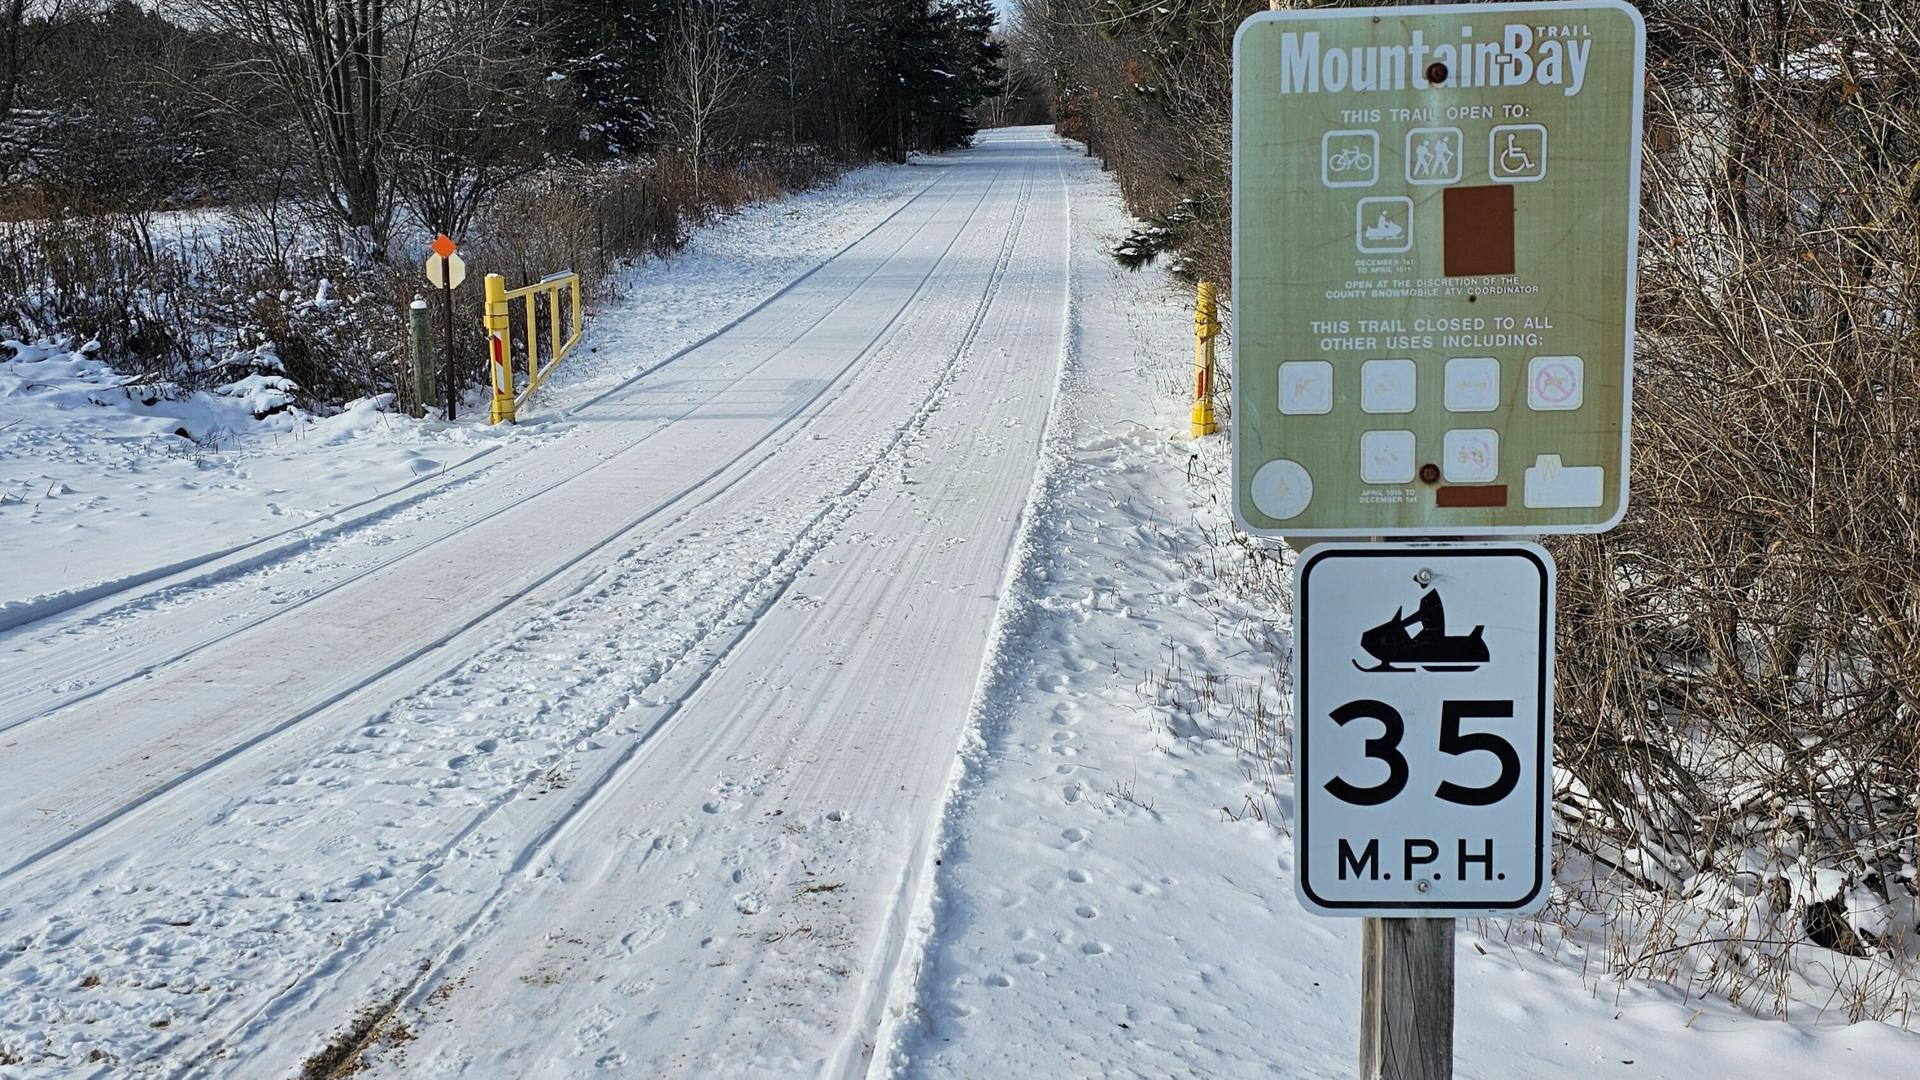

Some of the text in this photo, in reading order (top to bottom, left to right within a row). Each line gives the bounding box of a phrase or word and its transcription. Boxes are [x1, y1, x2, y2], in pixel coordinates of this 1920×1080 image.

[1536, 25, 1591, 37] TRAIL
[1341, 104, 1530, 123] THIS TRAIL OPEN TO:
[1326, 285, 1539, 299] COUNTY SNOWMOBILE ATV COORDINATOR
[1345, 281, 1372, 289] OPEN
[1377, 280, 1388, 288] AT
[1417, 278, 1478, 287] DISCRETION
[1483, 277, 1497, 285] OF
[1501, 277, 1520, 285] THE
[1310, 316, 1553, 334] THIS TRAIL CLOSED TO ALL
[1320, 333, 1543, 351] OTHER USES INCLUDING:
[1323, 699, 1521, 806] 35
[1338, 839, 1505, 881] M.P.H.
